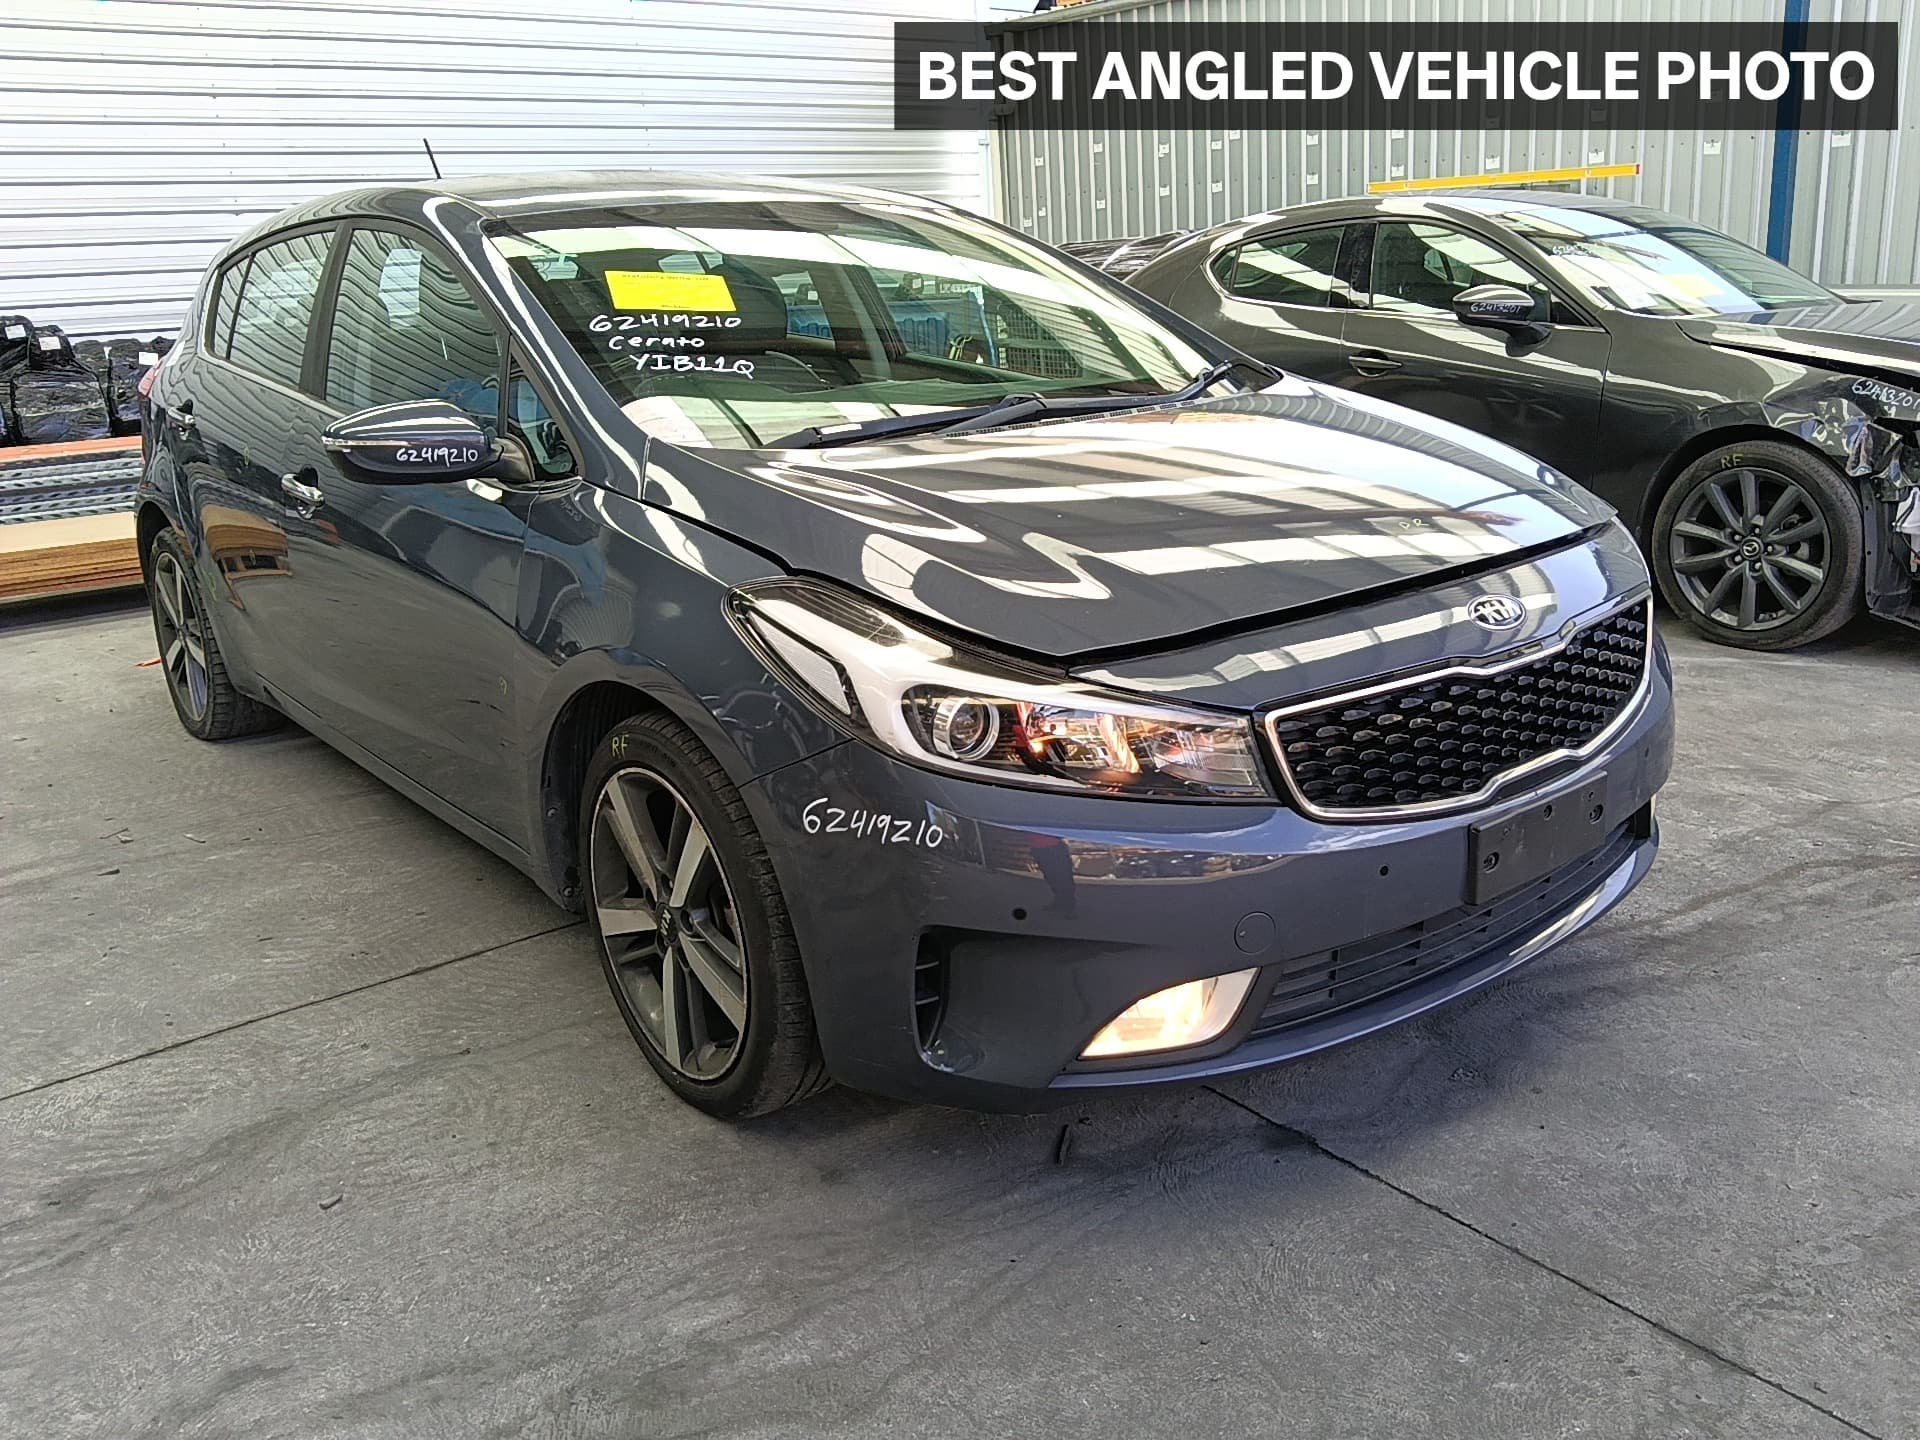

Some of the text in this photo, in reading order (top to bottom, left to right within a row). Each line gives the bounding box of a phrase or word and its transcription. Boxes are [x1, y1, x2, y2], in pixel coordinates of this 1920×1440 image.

[588, 313, 743, 332] 62419210
[395, 447, 479, 468] 62419210
[1720, 453, 1744, 469] RF
[612, 734, 630, 759] RF
[802, 797, 944, 848] 62419210
